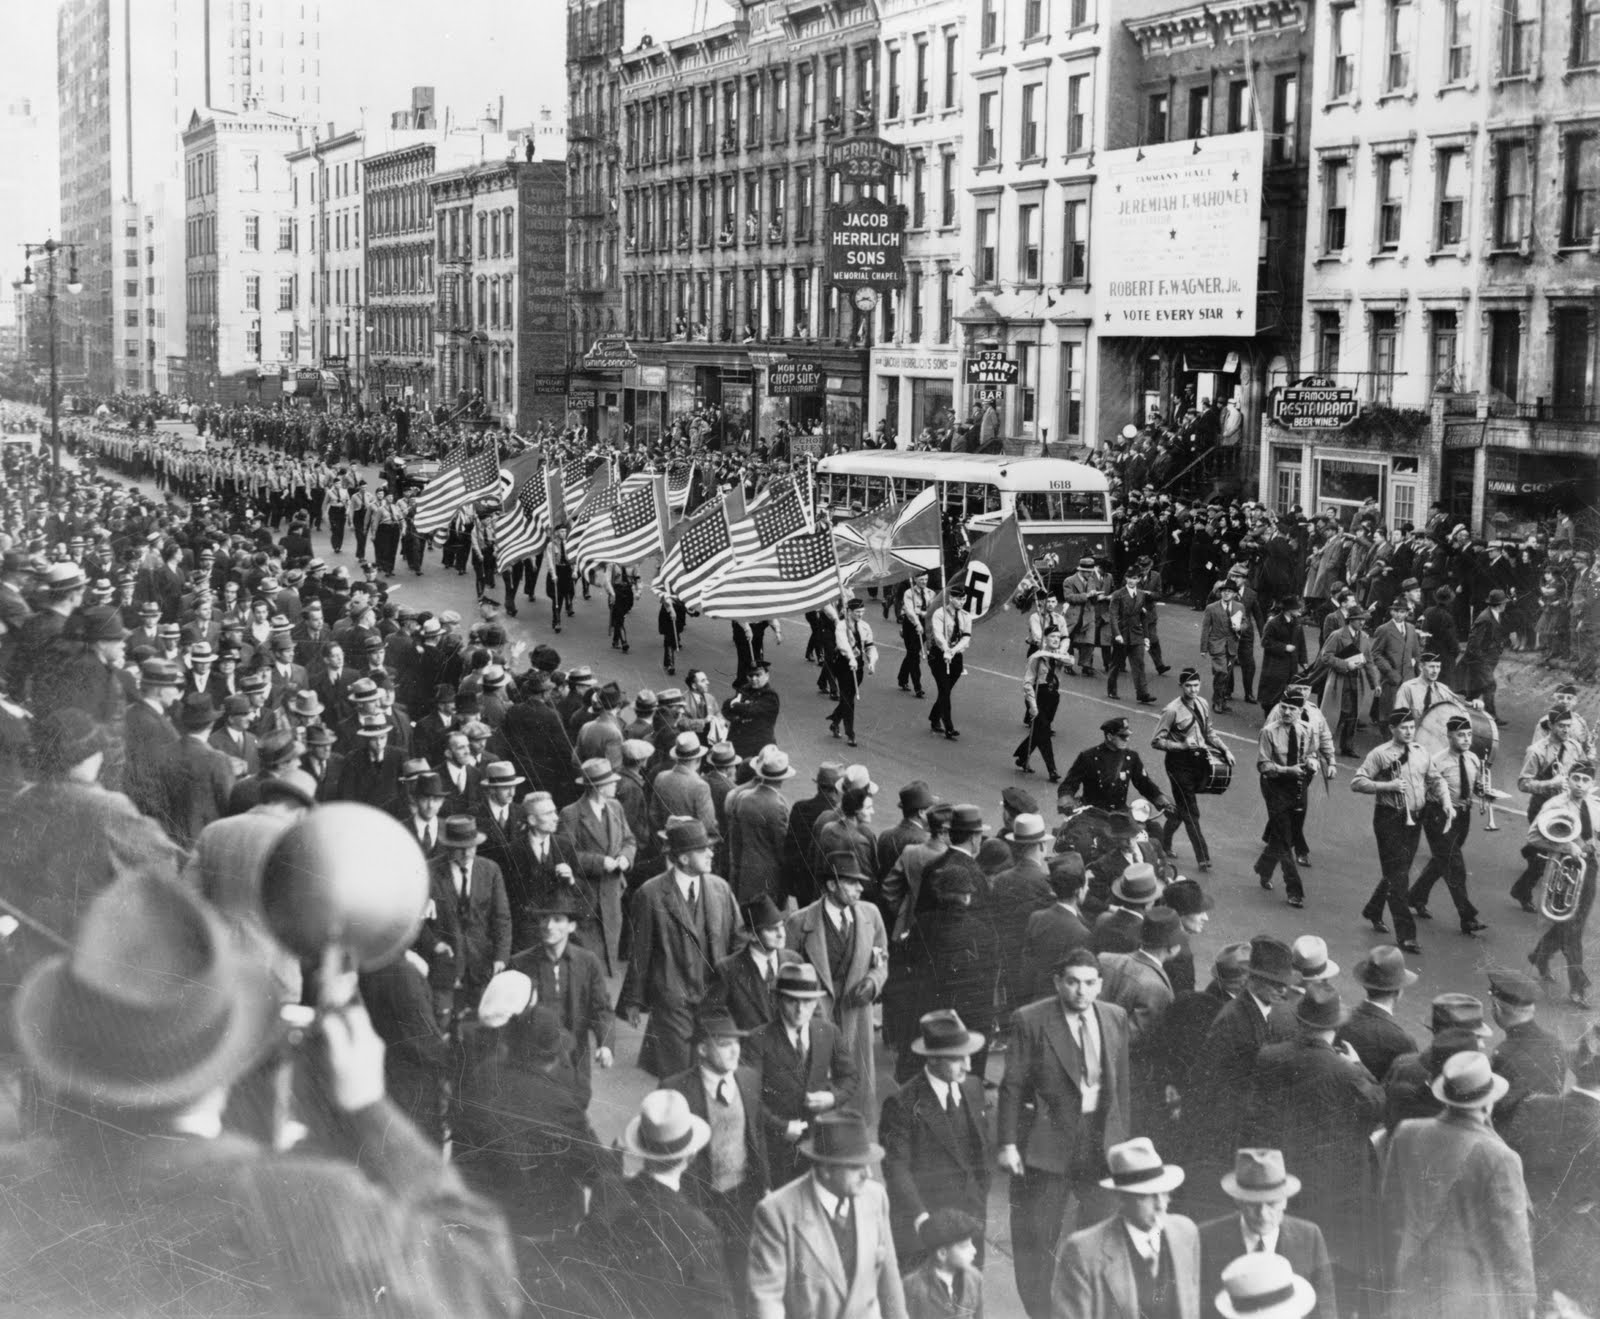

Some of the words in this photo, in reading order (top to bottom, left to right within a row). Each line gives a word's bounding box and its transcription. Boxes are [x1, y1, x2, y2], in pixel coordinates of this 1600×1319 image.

[833, 142, 898, 167] HERRLICH
[849, 160, 882, 176] 332
[1118, 195, 1177, 215] JEREMIAH
[1192, 188, 1248, 208] MAHONEY
[843, 213, 889, 227] JACOB
[833, 232, 900, 246] HERRLICH
[847, 251, 886, 265] SONS
[833, 271, 869, 280] MEMORIAL
[872, 271, 898, 280] CHAPEL
[1109, 280, 1154, 297] ROBERT
[1123, 309, 1150, 321] VOTE
[1156, 309, 1194, 321] EVERY
[1199, 308, 1223, 319] STAR
[984, 352, 1002, 360] 328
[933, 358, 948, 370] SONS
[970, 360, 1017, 374] MOZART
[297, 372, 319, 380] FLORIST
[770, 373, 795, 384] CHOP
[796, 373, 820, 384] SUEY
[978, 372, 1007, 381] HALL
[980, 390, 1002, 400] BAR
[1299, 391, 1338, 400] FAMOUS
[569, 400, 595, 408] HATS
[1279, 401, 1355, 416] RESTAURANT
[1445, 434, 1481, 446] CIGARS
[1049, 480, 1072, 489] 1618
[1488, 481, 1516, 493] HAVANA
